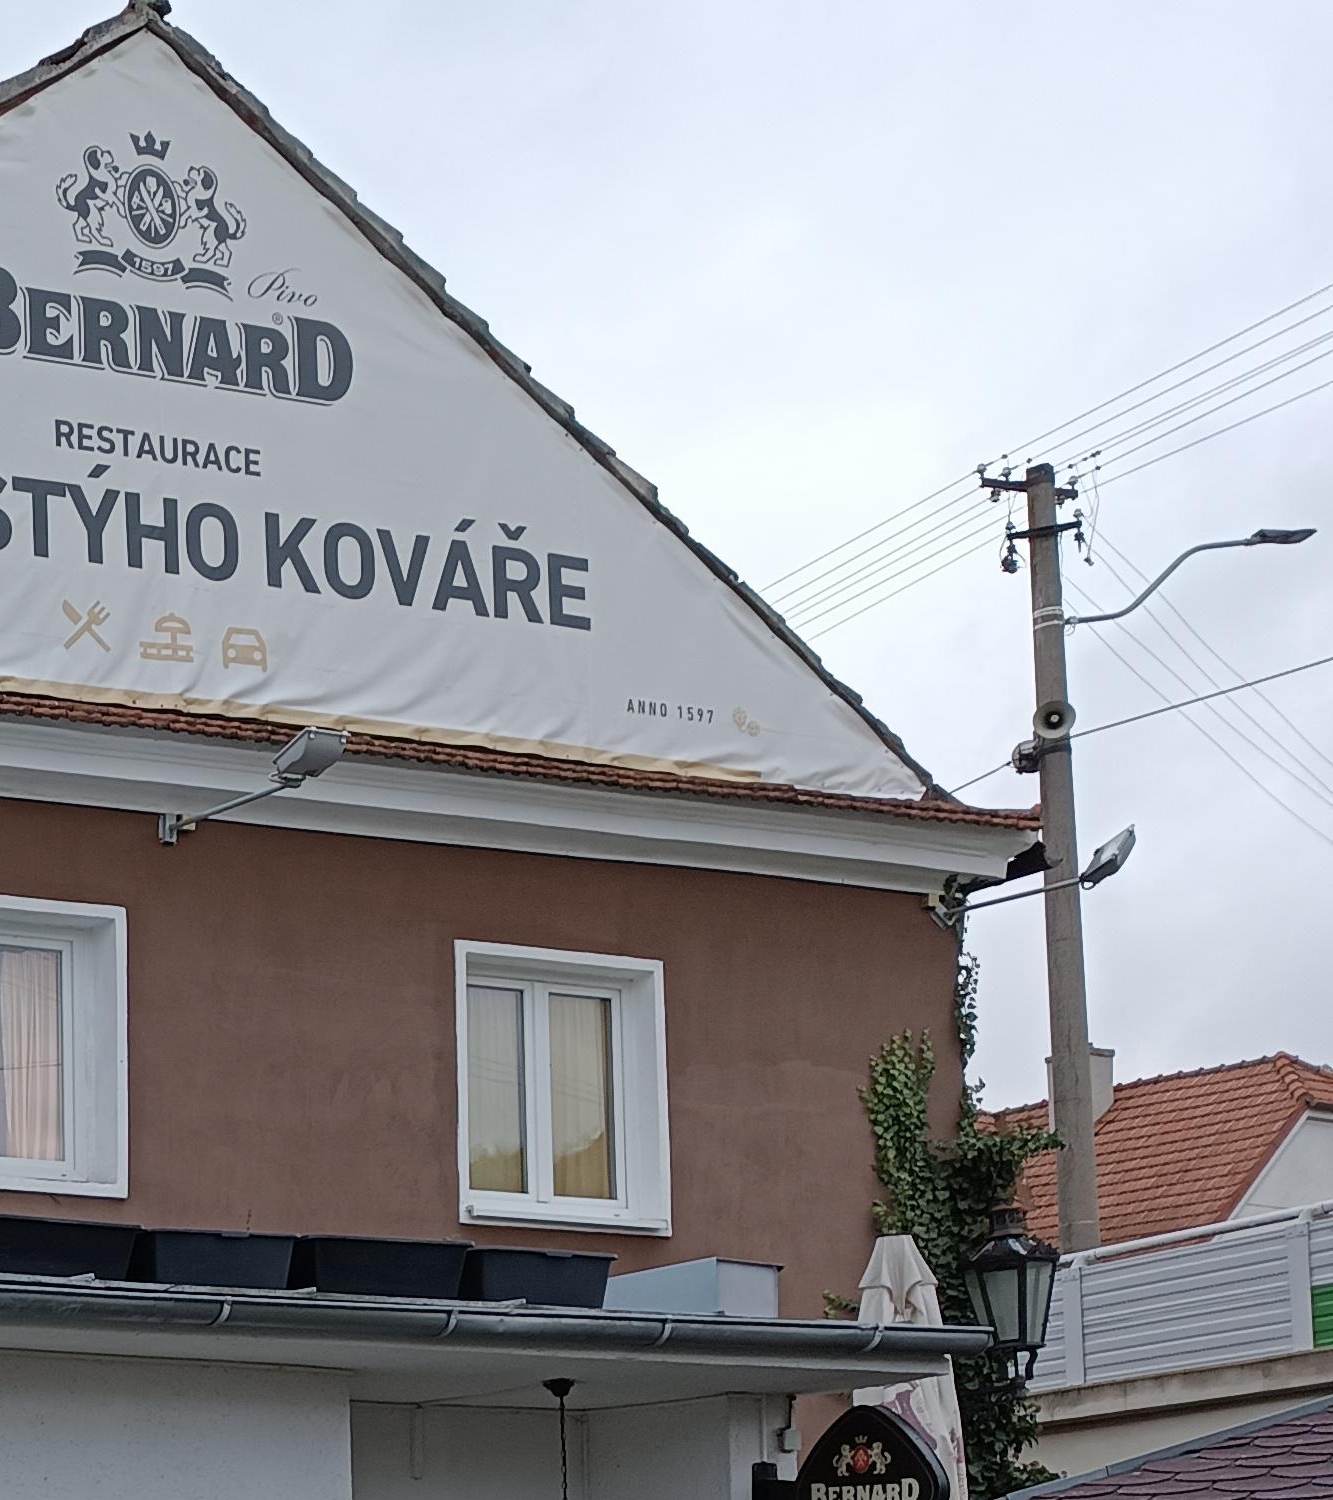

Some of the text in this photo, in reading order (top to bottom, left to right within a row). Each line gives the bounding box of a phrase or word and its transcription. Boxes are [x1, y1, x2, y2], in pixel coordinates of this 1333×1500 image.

[132, 256, 175, 276] 1597
[247, 267, 319, 308] Pivo
[54, 418, 262, 478] RESTAURACE
[264, 511, 592, 631] KOVÁŘE
[626, 698, 715, 724] ANNO 1597
